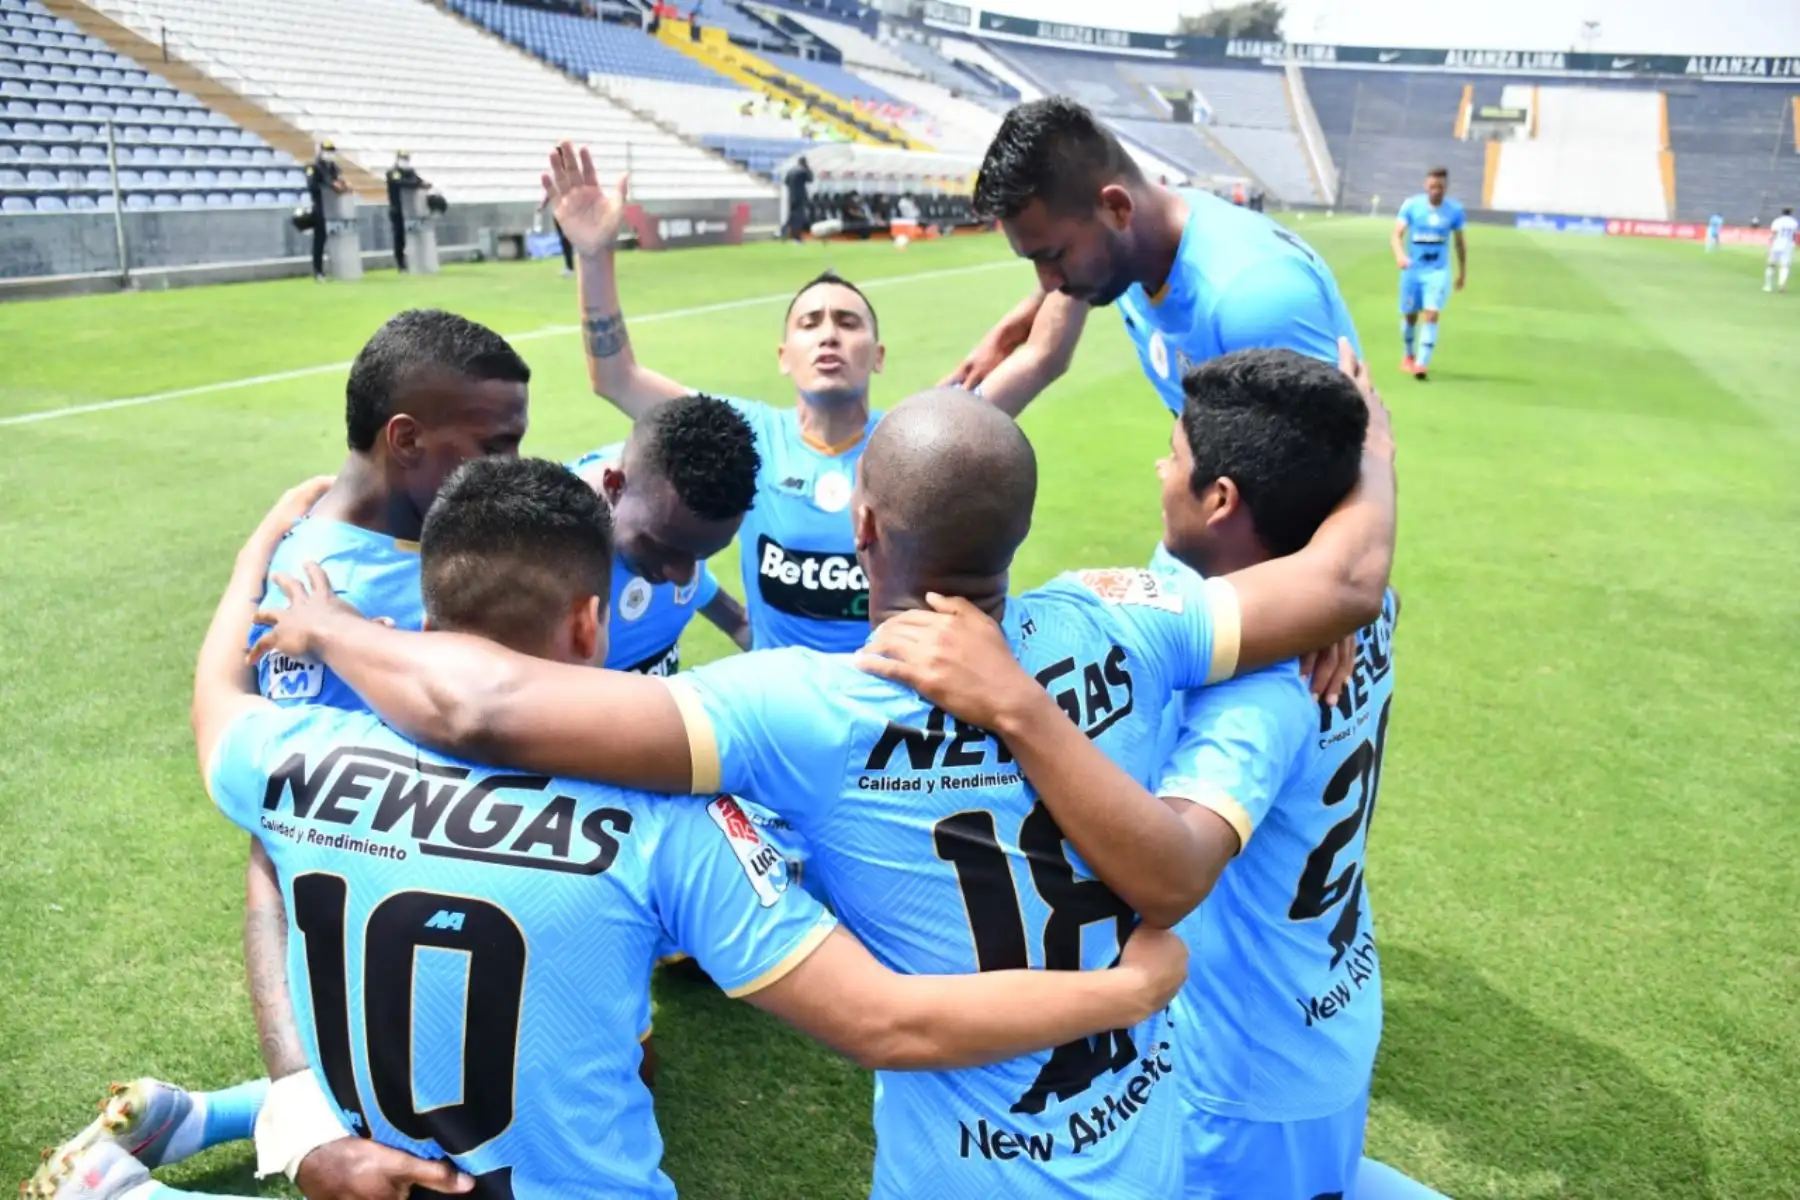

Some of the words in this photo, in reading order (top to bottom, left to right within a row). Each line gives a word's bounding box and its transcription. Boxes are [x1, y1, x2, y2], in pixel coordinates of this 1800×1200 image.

[1685, 56, 1767, 76] ALIANZA
[858, 774, 922, 791] Calidad
[926, 778, 936, 794] y
[262, 745, 634, 876] NEWGAS
[296, 829, 304, 844] y
[306, 828, 407, 861] Rendimiento
[292, 870, 527, 1157] 10
[1296, 979, 1351, 1027] New
[958, 1119, 1054, 1162] New
[1068, 1040, 1173, 1155] Athletc
